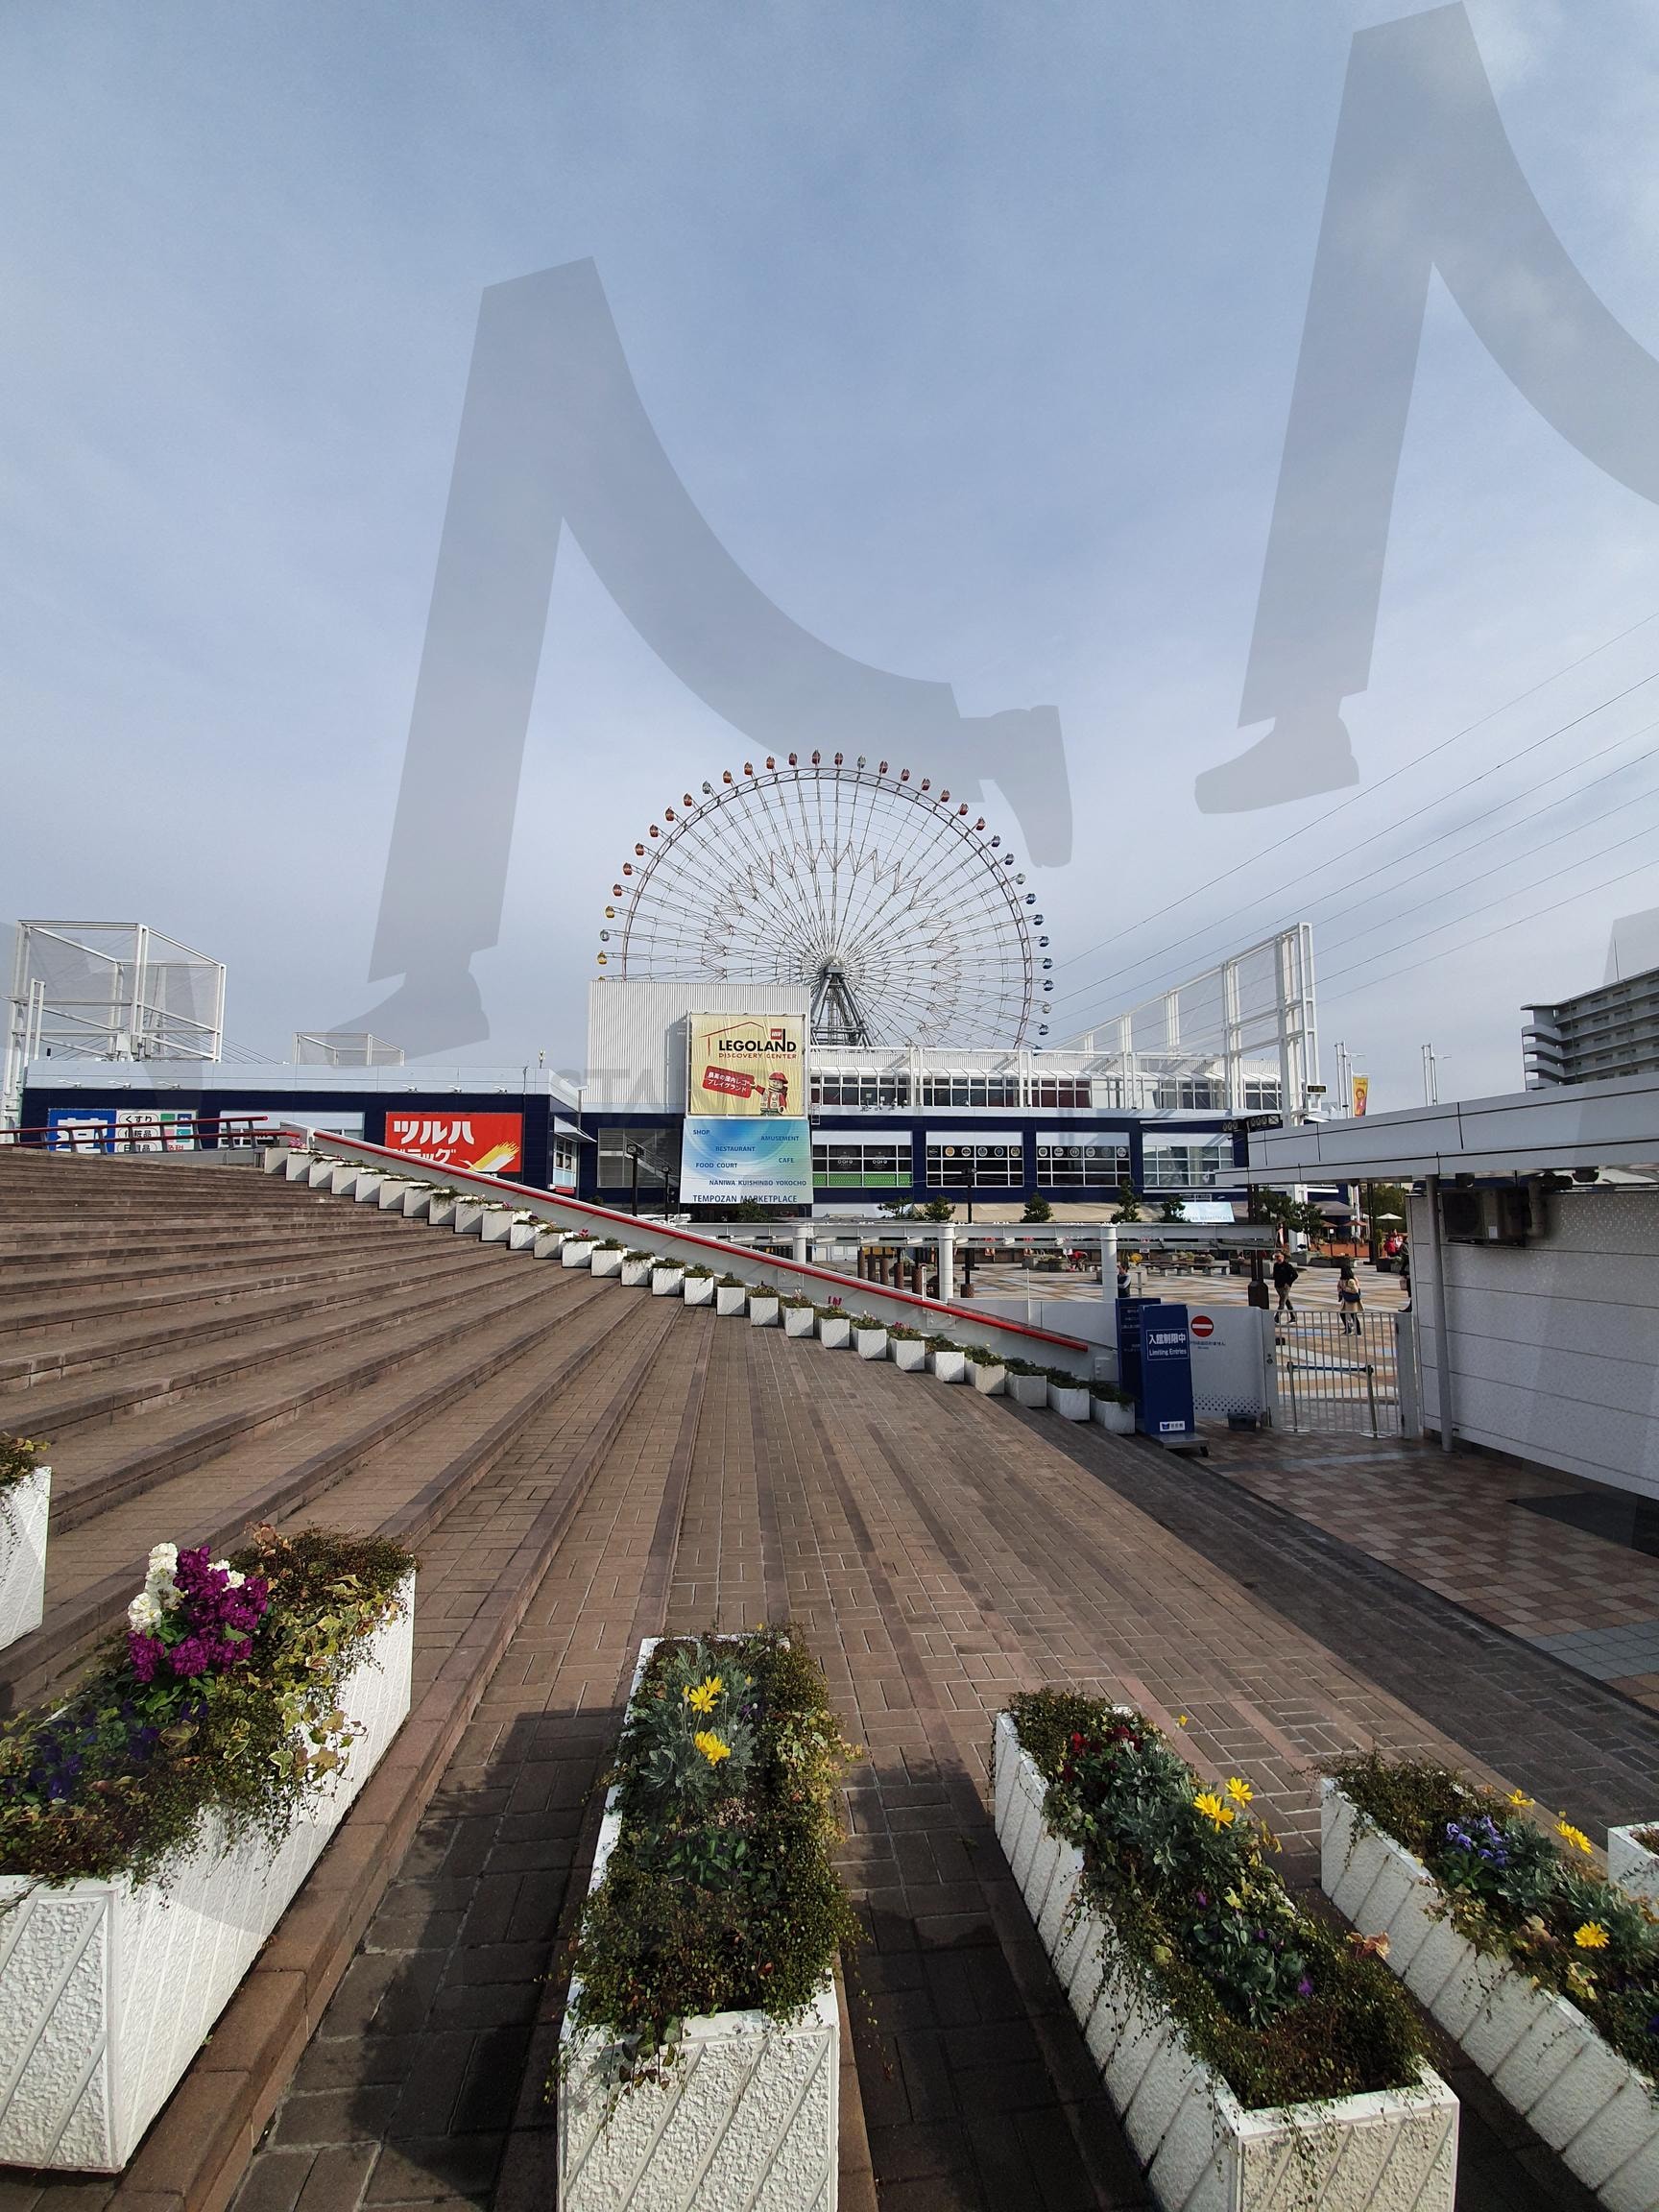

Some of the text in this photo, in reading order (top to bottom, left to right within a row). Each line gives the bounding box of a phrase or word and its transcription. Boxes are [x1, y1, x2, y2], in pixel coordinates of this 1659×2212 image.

[719, 1029, 796, 1051] LEGOLAND
[125, 1115, 153, 1123] くすり
[394, 1121, 474, 1145] ツルハ
[1148, 1333, 1186, 1345] 入館制限中
